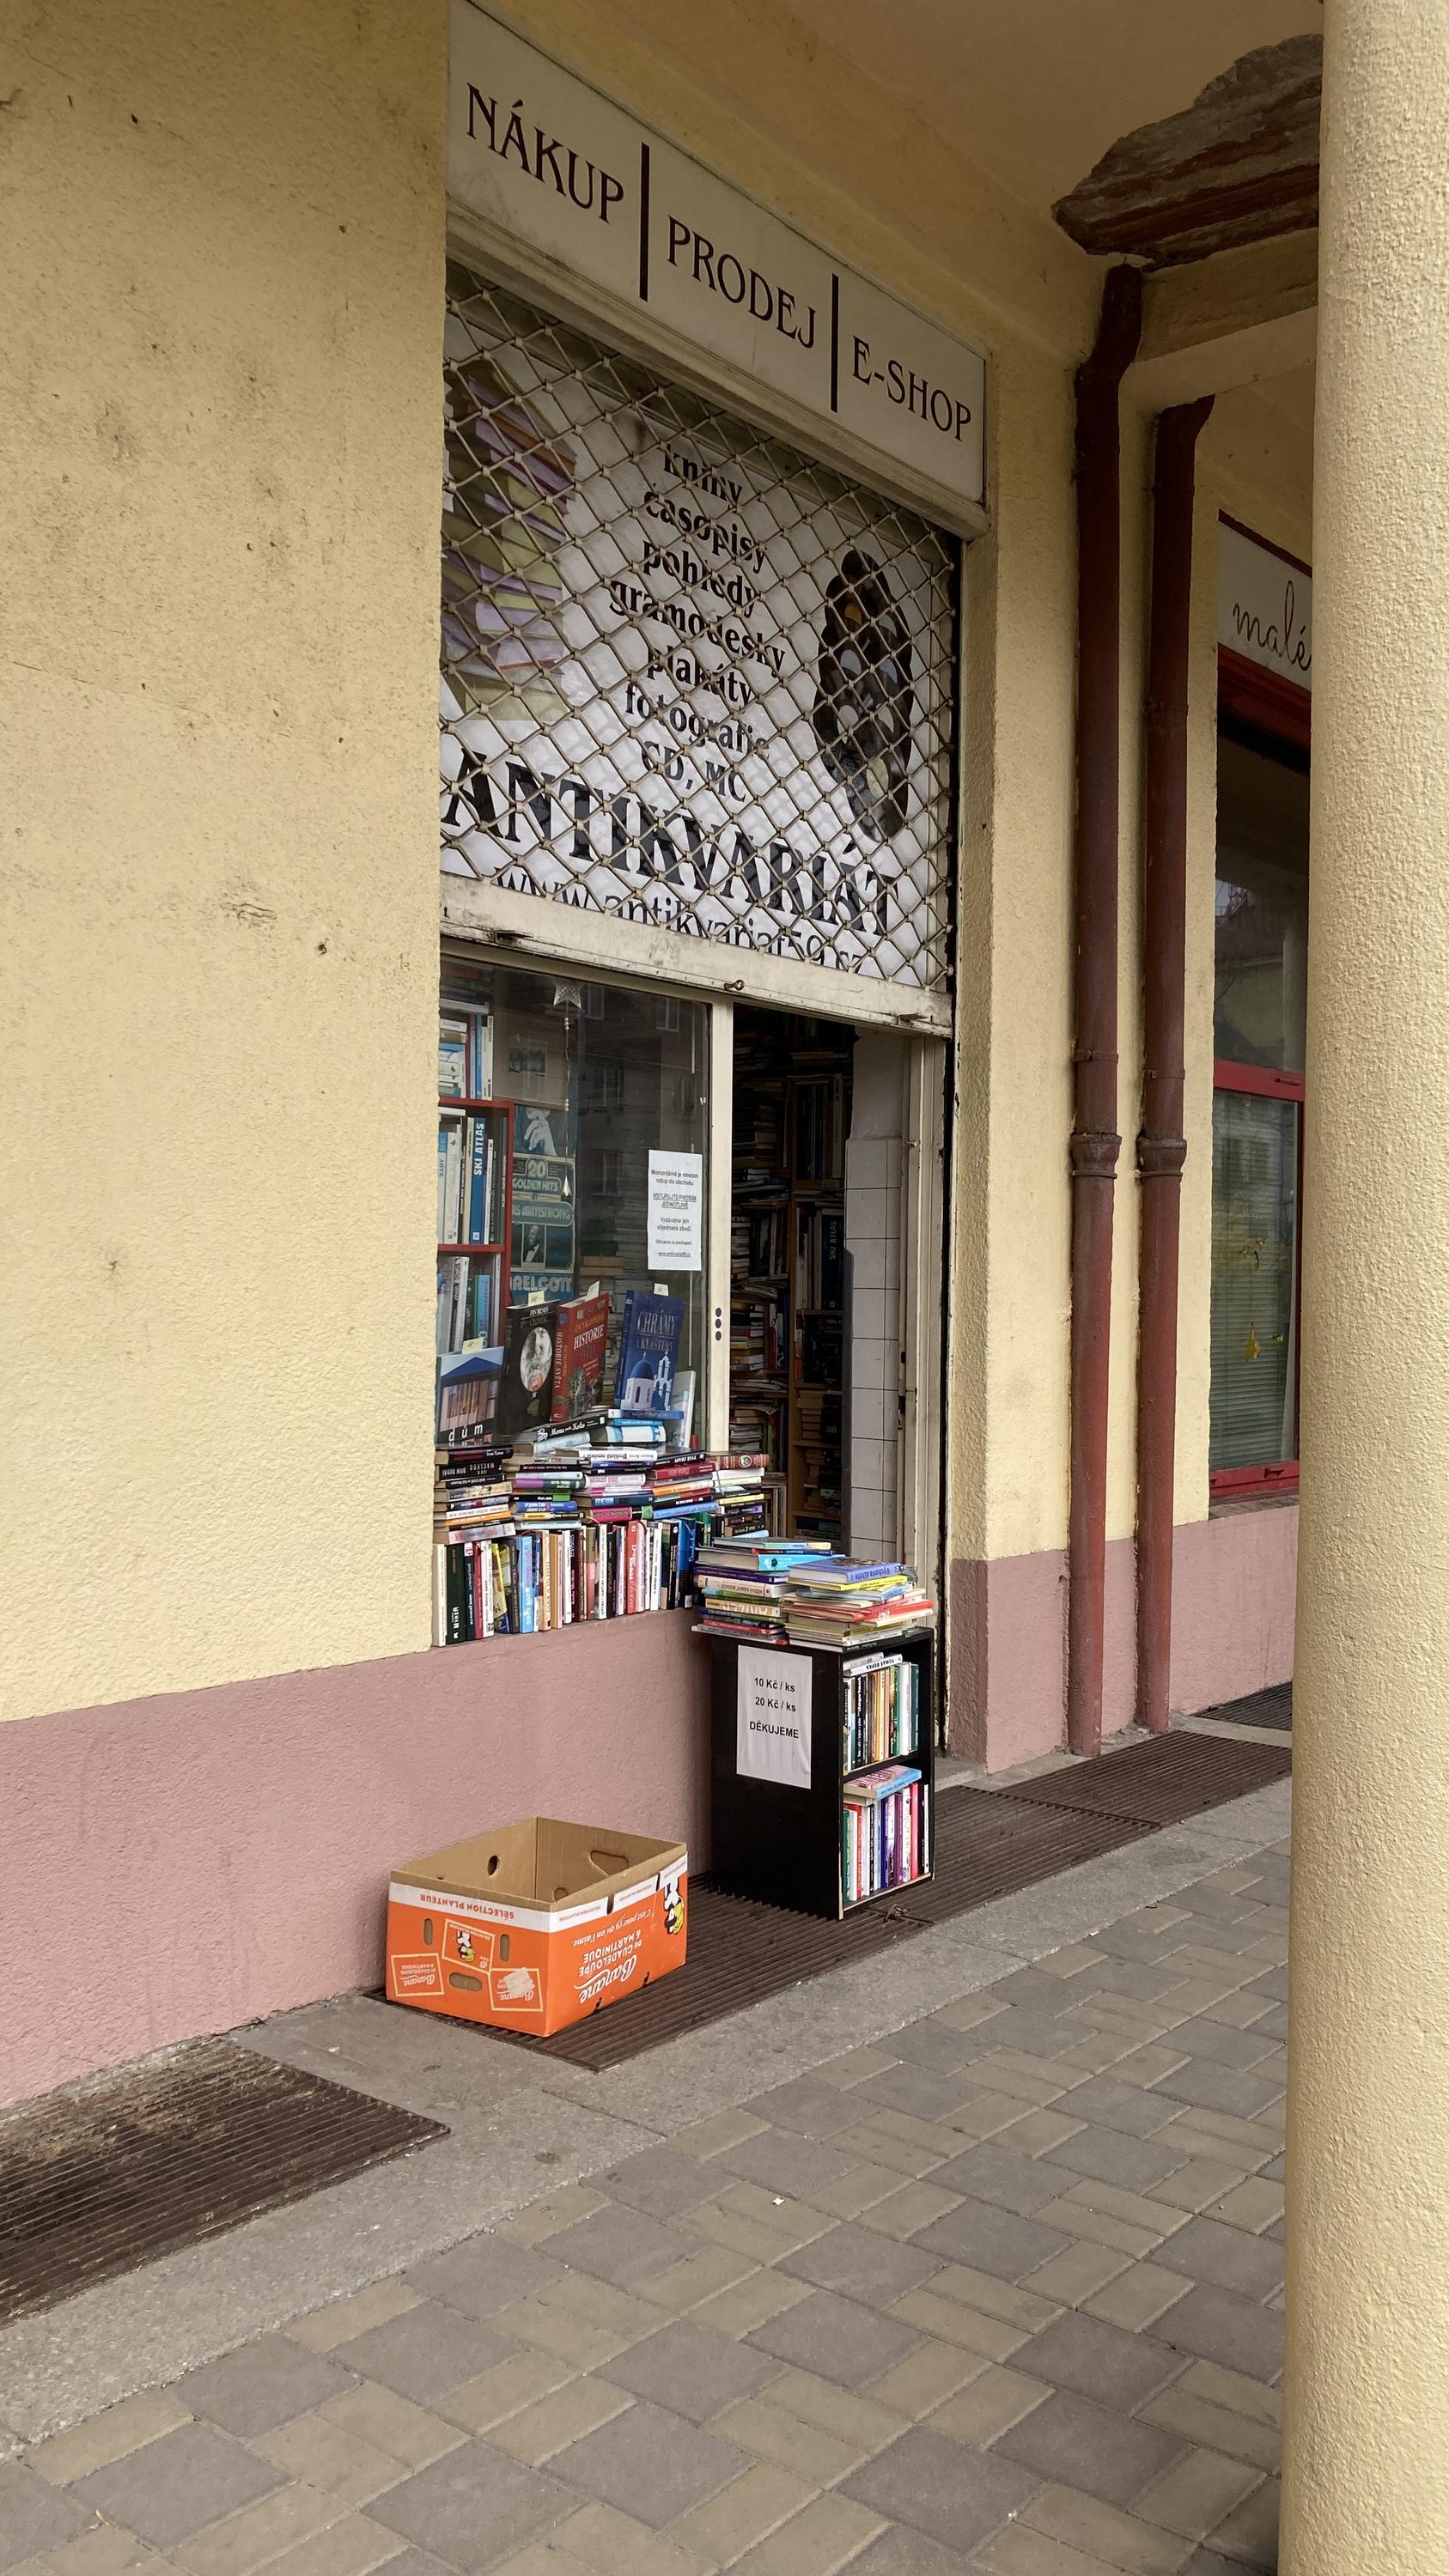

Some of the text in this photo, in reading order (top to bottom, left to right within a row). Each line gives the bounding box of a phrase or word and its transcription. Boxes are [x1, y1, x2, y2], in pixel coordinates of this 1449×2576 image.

[466, 82, 624, 223] NÁKUP
[667, 215, 816, 349] PRODEJ
[852, 335, 971, 442] E-SHOP
[663, 442, 743, 510] knihy
[644, 483, 767, 574] časopisy
[642, 540, 755, 618] pohledy
[609, 580, 786, 678] gramodesky
[1233, 580, 1312, 671] malé
[647, 645, 752, 714] plakáty
[705, 760, 746, 803] MC
[444, 744, 898, 938] ANTIKVARIÁT
[474, 1122, 484, 1176] SKI ATLAS
[527, 1159, 546, 1177] 20
[512, 1177, 558, 1191] GOLDEN HITS
[521, 1205, 571, 1219] ARMSTRONG
[573, 1324, 605, 1350] HISTORIE
[636, 1309, 678, 1336] CHRÁMY
[754, 1677, 764, 1687] 10
[766, 1677, 778, 1689] Kč
[785, 1681, 795, 1692] ks
[755, 1696, 765, 1707] 20
[767, 1698, 779, 1709] Kč
[786, 1703, 796, 1712] ks
[749, 1720, 799, 1740] DĚKUJEME
[419, 1893, 514, 1920] SÉLECTION PLANTEUR
[579, 1939, 642, 1978] DE GUADELOUPE
[583, 1932, 636, 1964] MARTINIQUE
[399, 1974, 435, 1987] Banane
[574, 1954, 637, 2004] Banane
